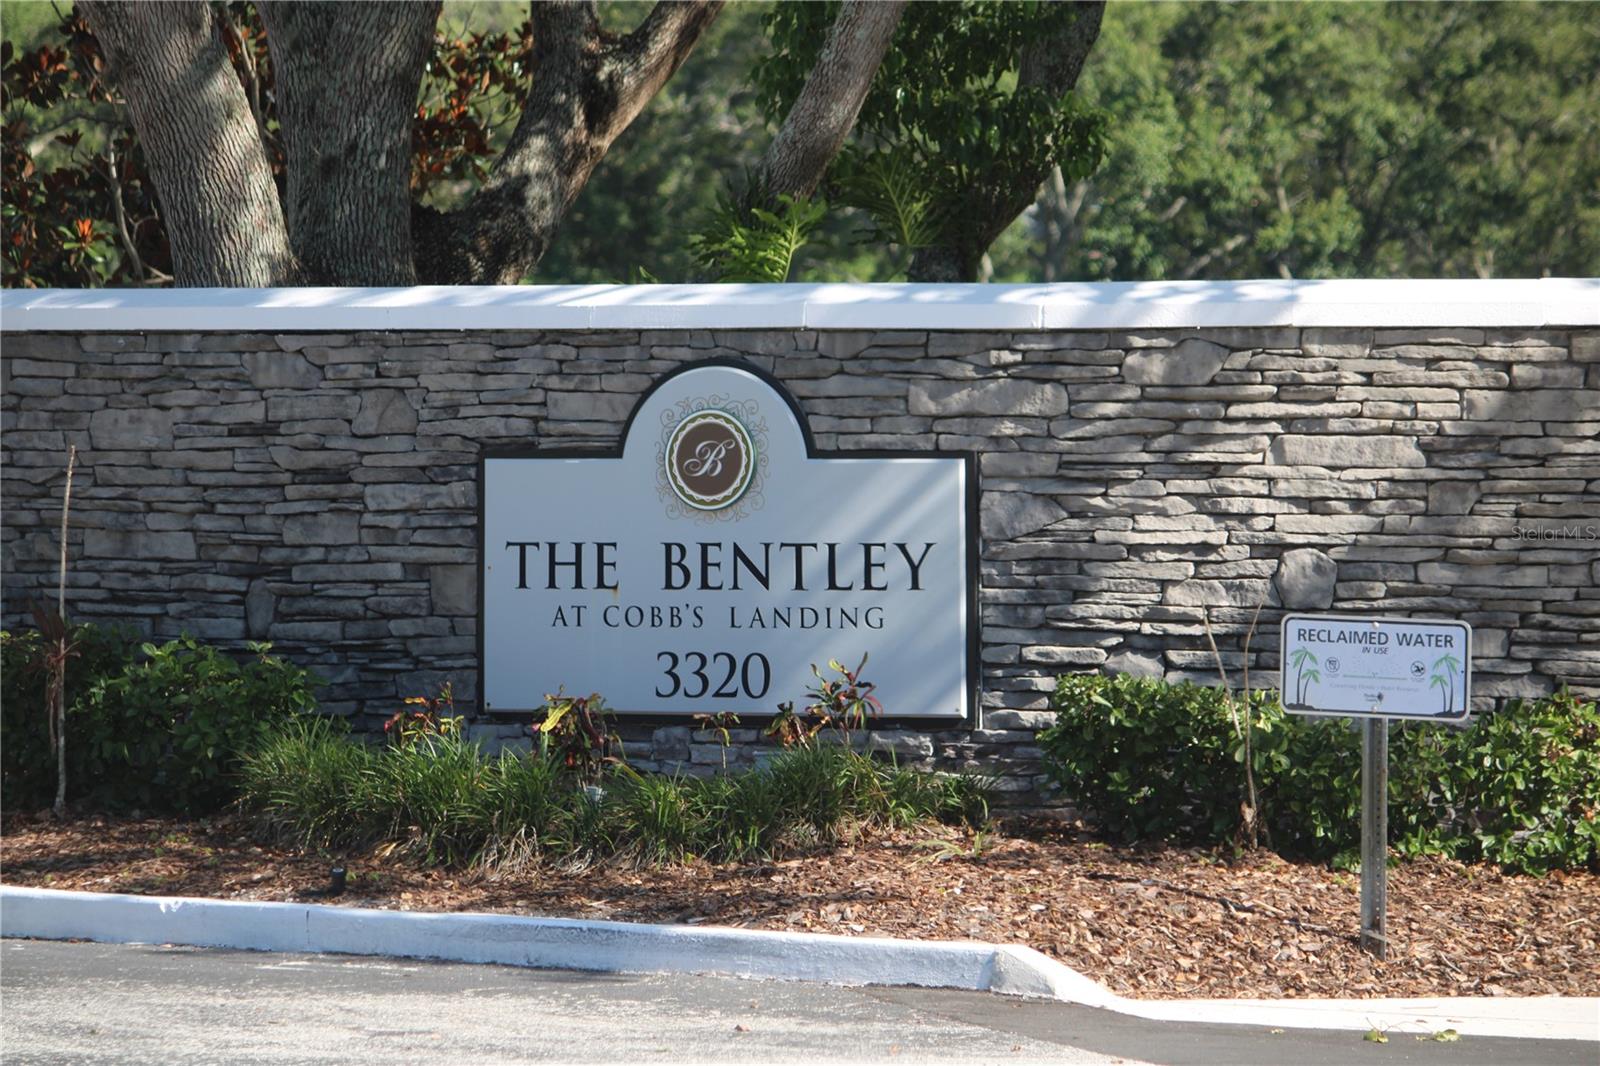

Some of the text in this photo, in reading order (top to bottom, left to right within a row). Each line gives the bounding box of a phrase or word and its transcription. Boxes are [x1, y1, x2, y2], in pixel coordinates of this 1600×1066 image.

[505, 541, 936, 591] THE BENTLEY
[552, 603, 885, 630] AT COBB'S LANDING
[1297, 628, 1454, 648] RECLAIMED WATER
[1373, 647, 1390, 655] USE
[655, 651, 771, 699] 3320
